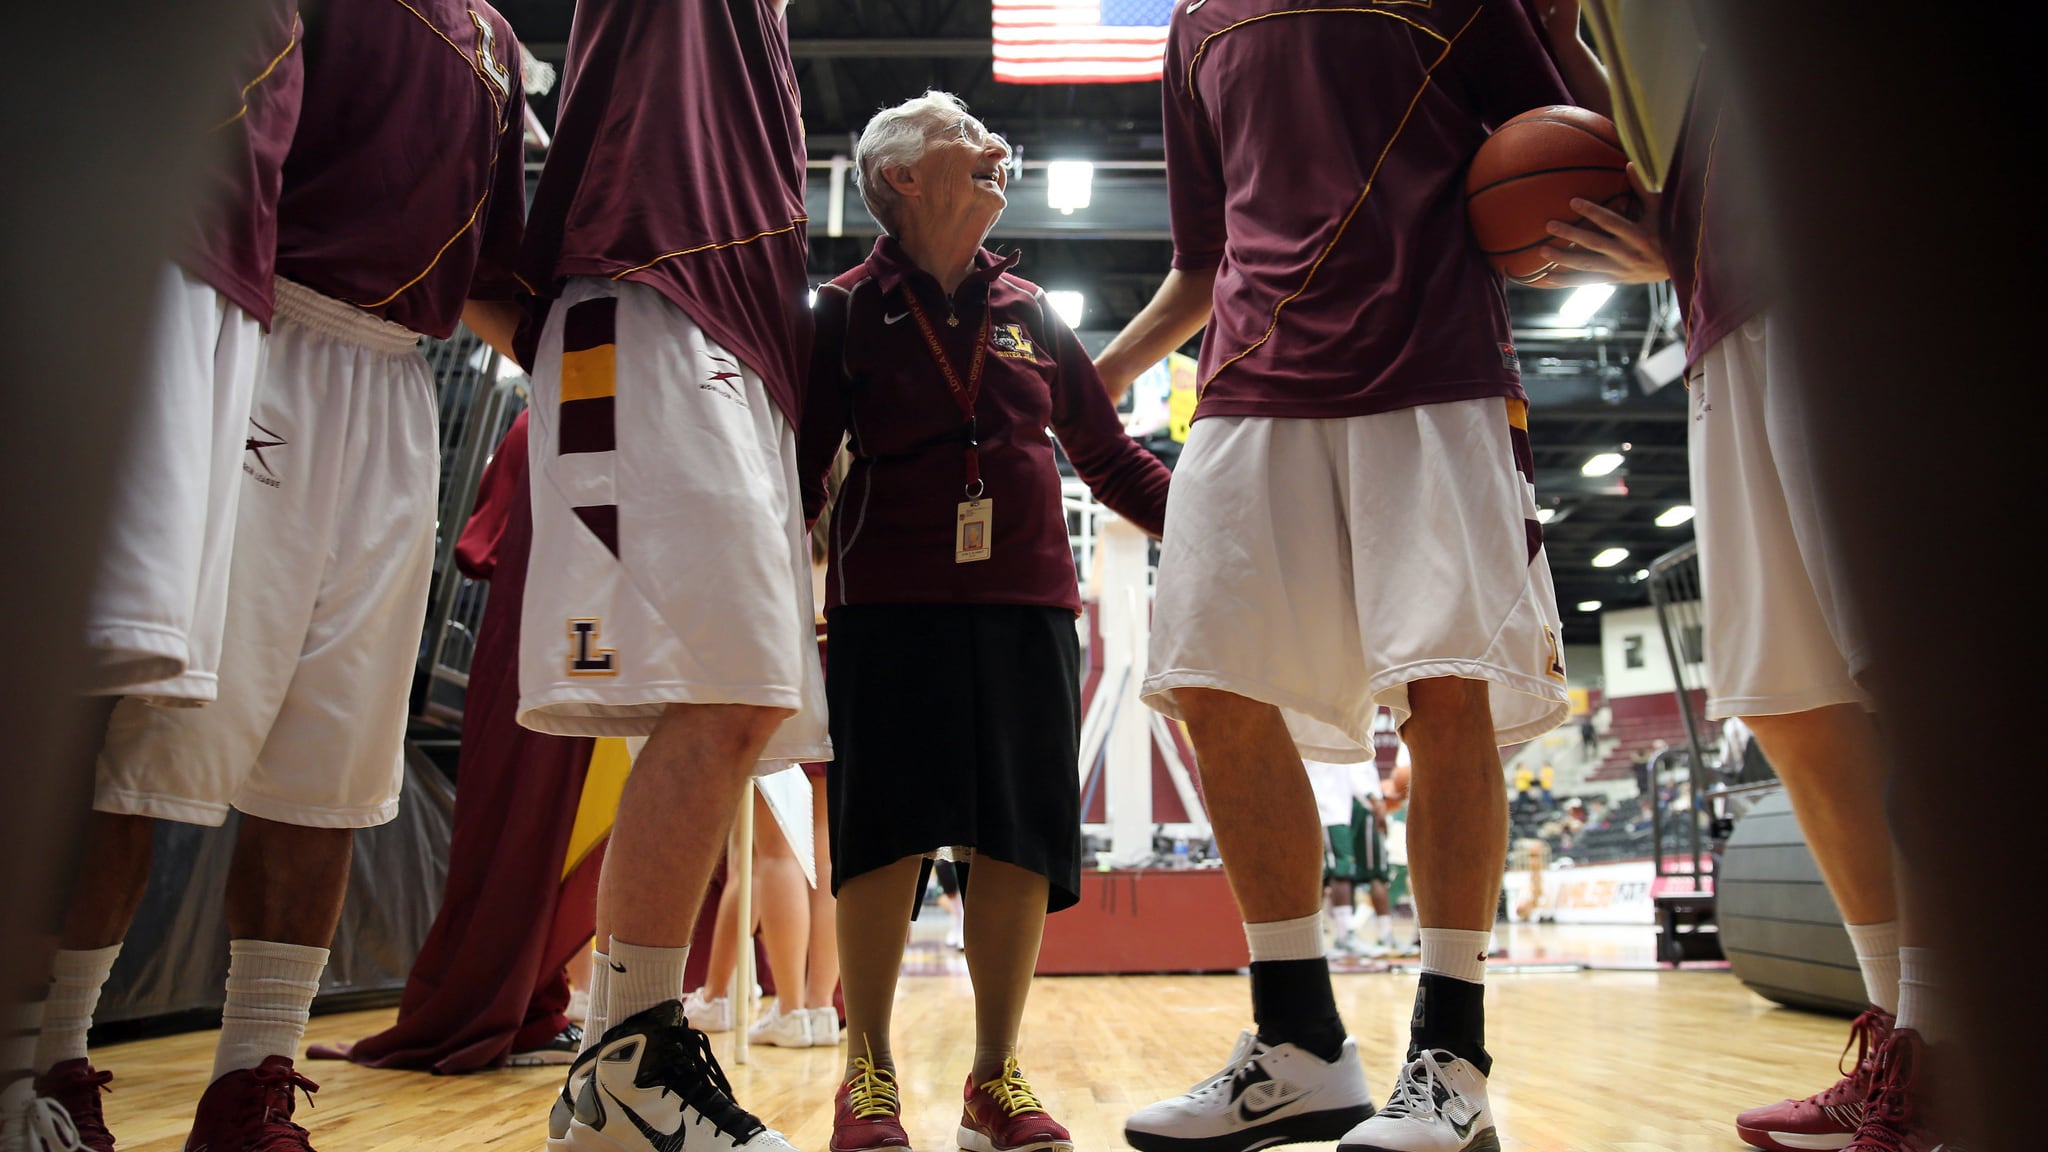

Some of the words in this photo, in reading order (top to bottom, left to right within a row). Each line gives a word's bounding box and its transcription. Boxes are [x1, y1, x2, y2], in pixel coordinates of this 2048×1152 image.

[467, 9, 511, 103] L
[1006, 324, 1033, 354] L
[940, 356, 960, 393] LOYOLA
[565, 616, 620, 678] L
